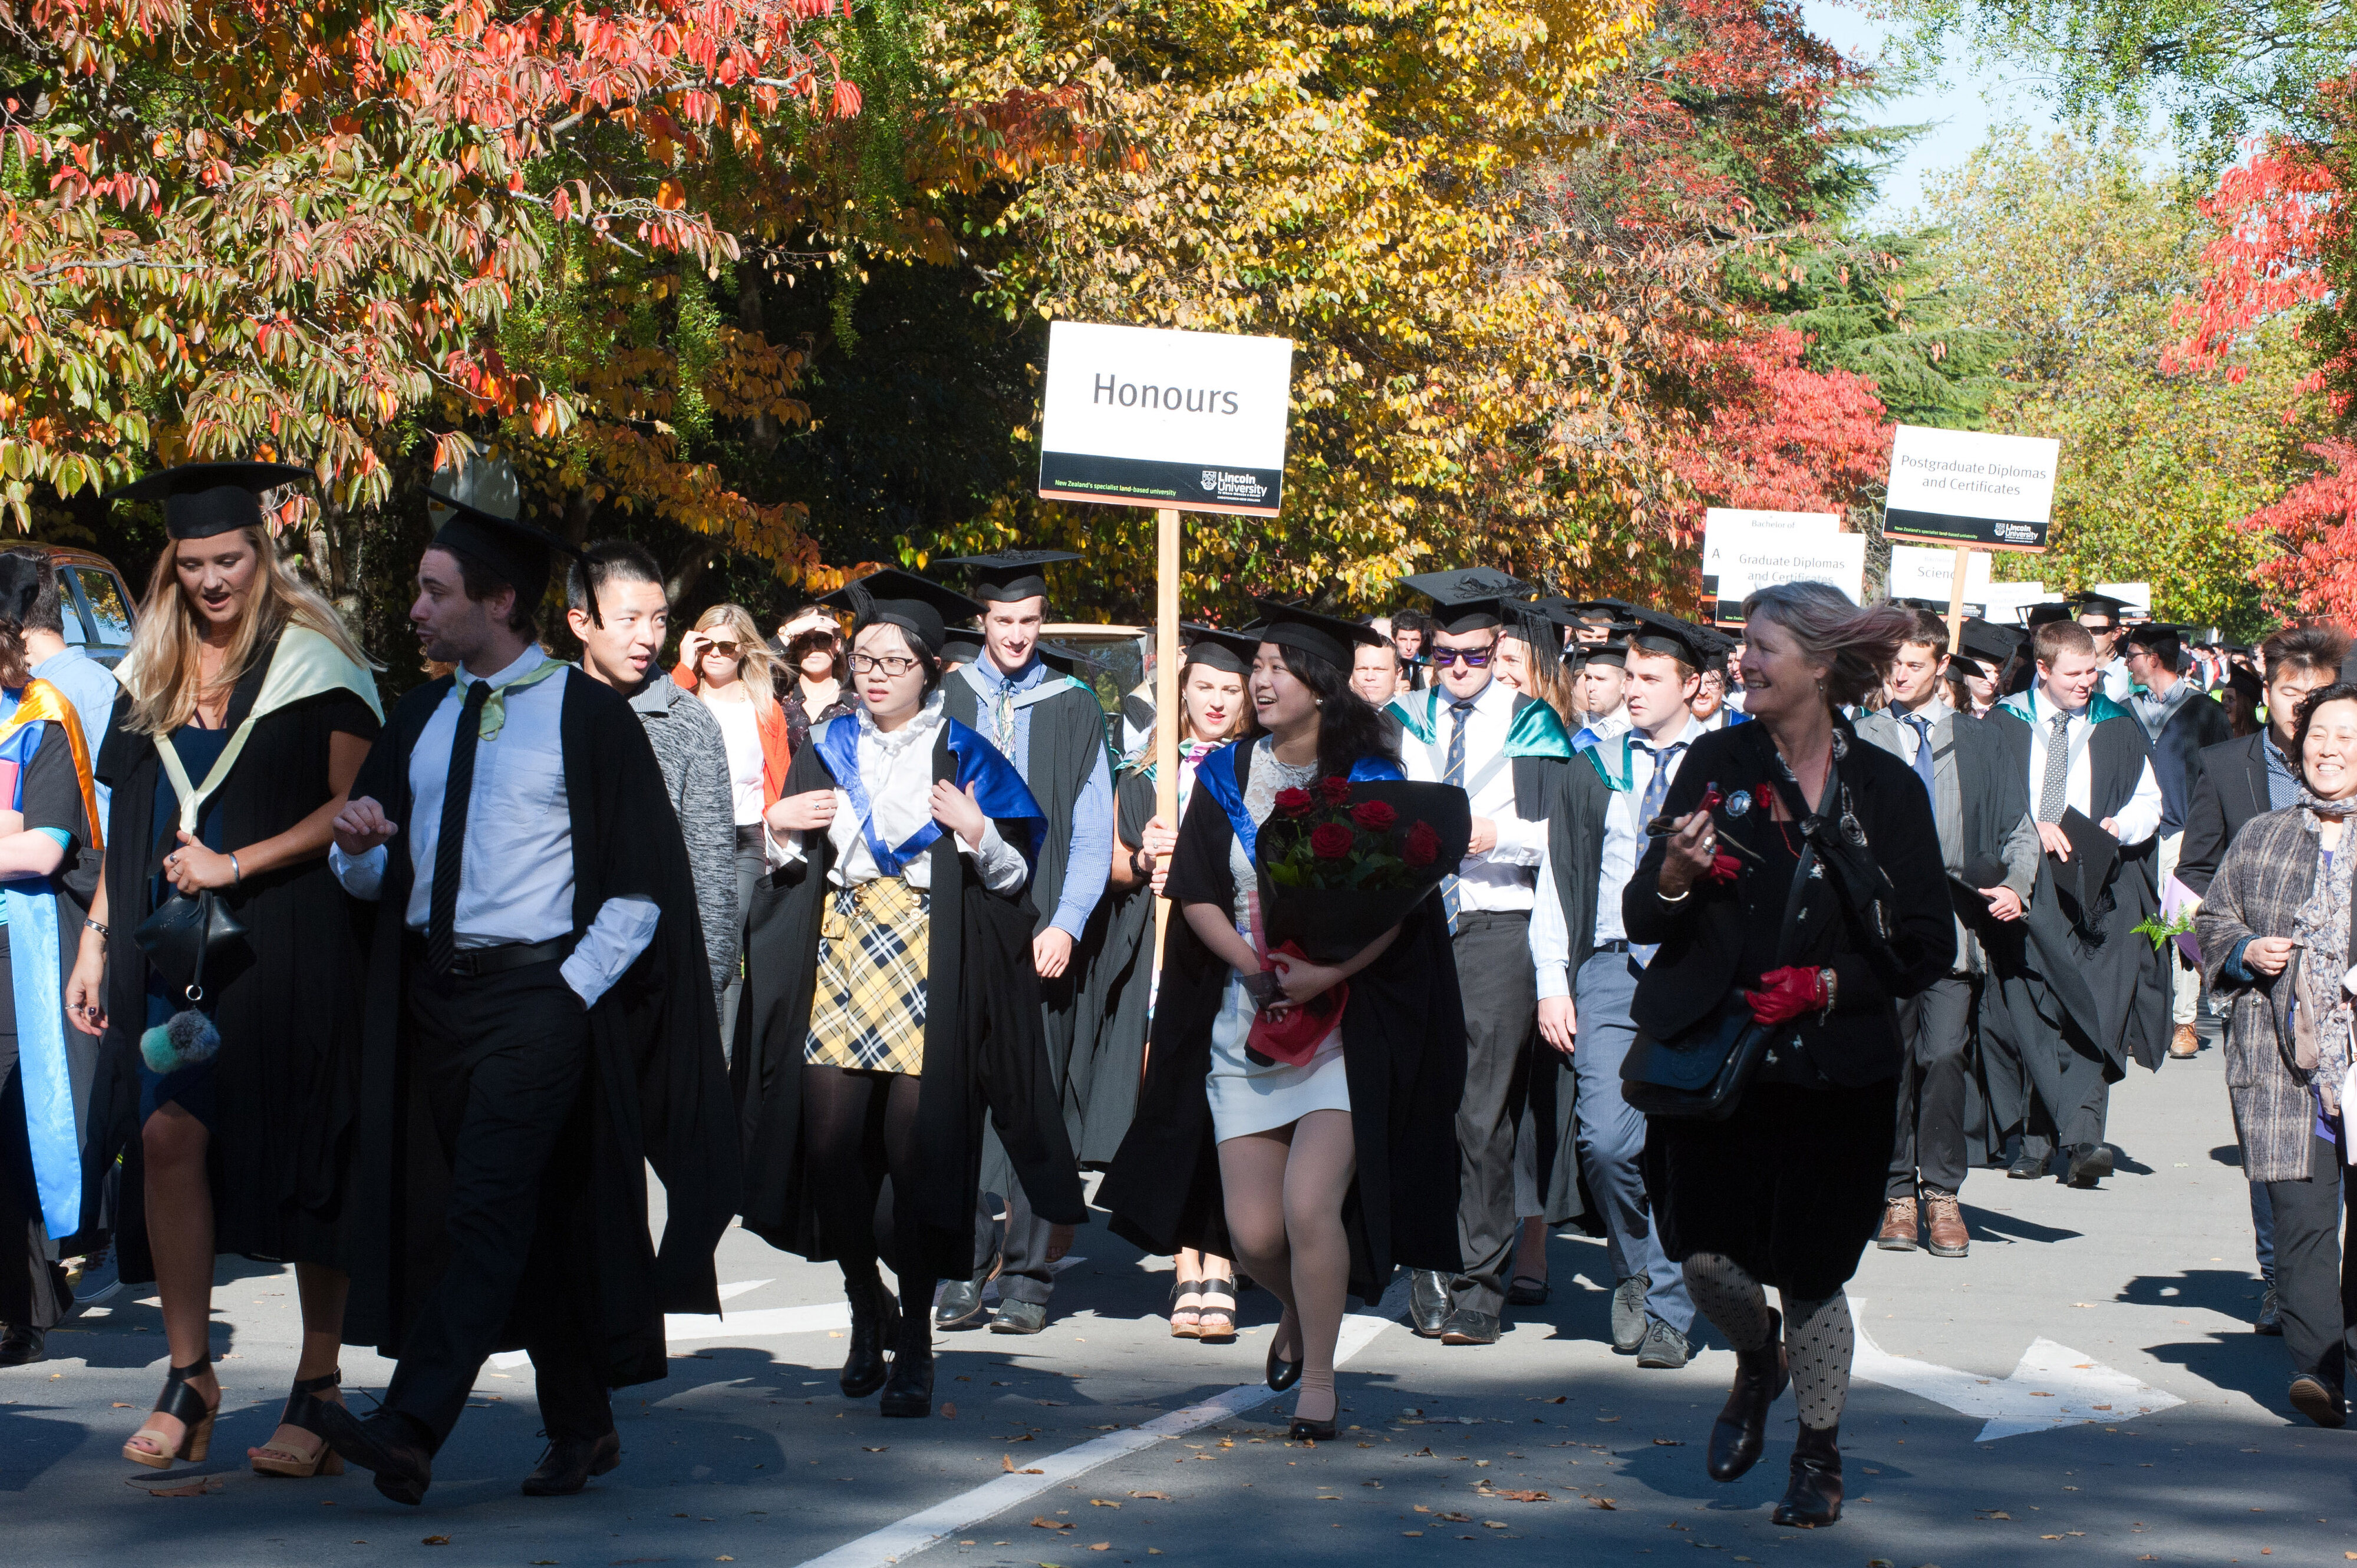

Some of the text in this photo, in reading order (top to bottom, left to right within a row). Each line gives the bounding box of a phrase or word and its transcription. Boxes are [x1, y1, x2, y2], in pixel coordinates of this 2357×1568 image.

[1093, 372, 1238, 415] Honours
[1901, 455, 2046, 480] Postgraduate Diplomas
[1218, 471, 1256, 484] Lincoln
[1067, 480, 1093, 488] Zealand's
[1149, 488, 1176, 497] university
[1217, 481, 1268, 497] University
[1922, 477, 2020, 496] and Certificates
[1751, 520, 1795, 529] Bachelor of
[2006, 523, 2031, 532] Lincoln
[2005, 529, 2038, 540] University
[1739, 554, 1845, 570] Graduate Diplomas
[1748, 570, 1768, 582] and
[1917, 566, 1955, 579] Scienc
